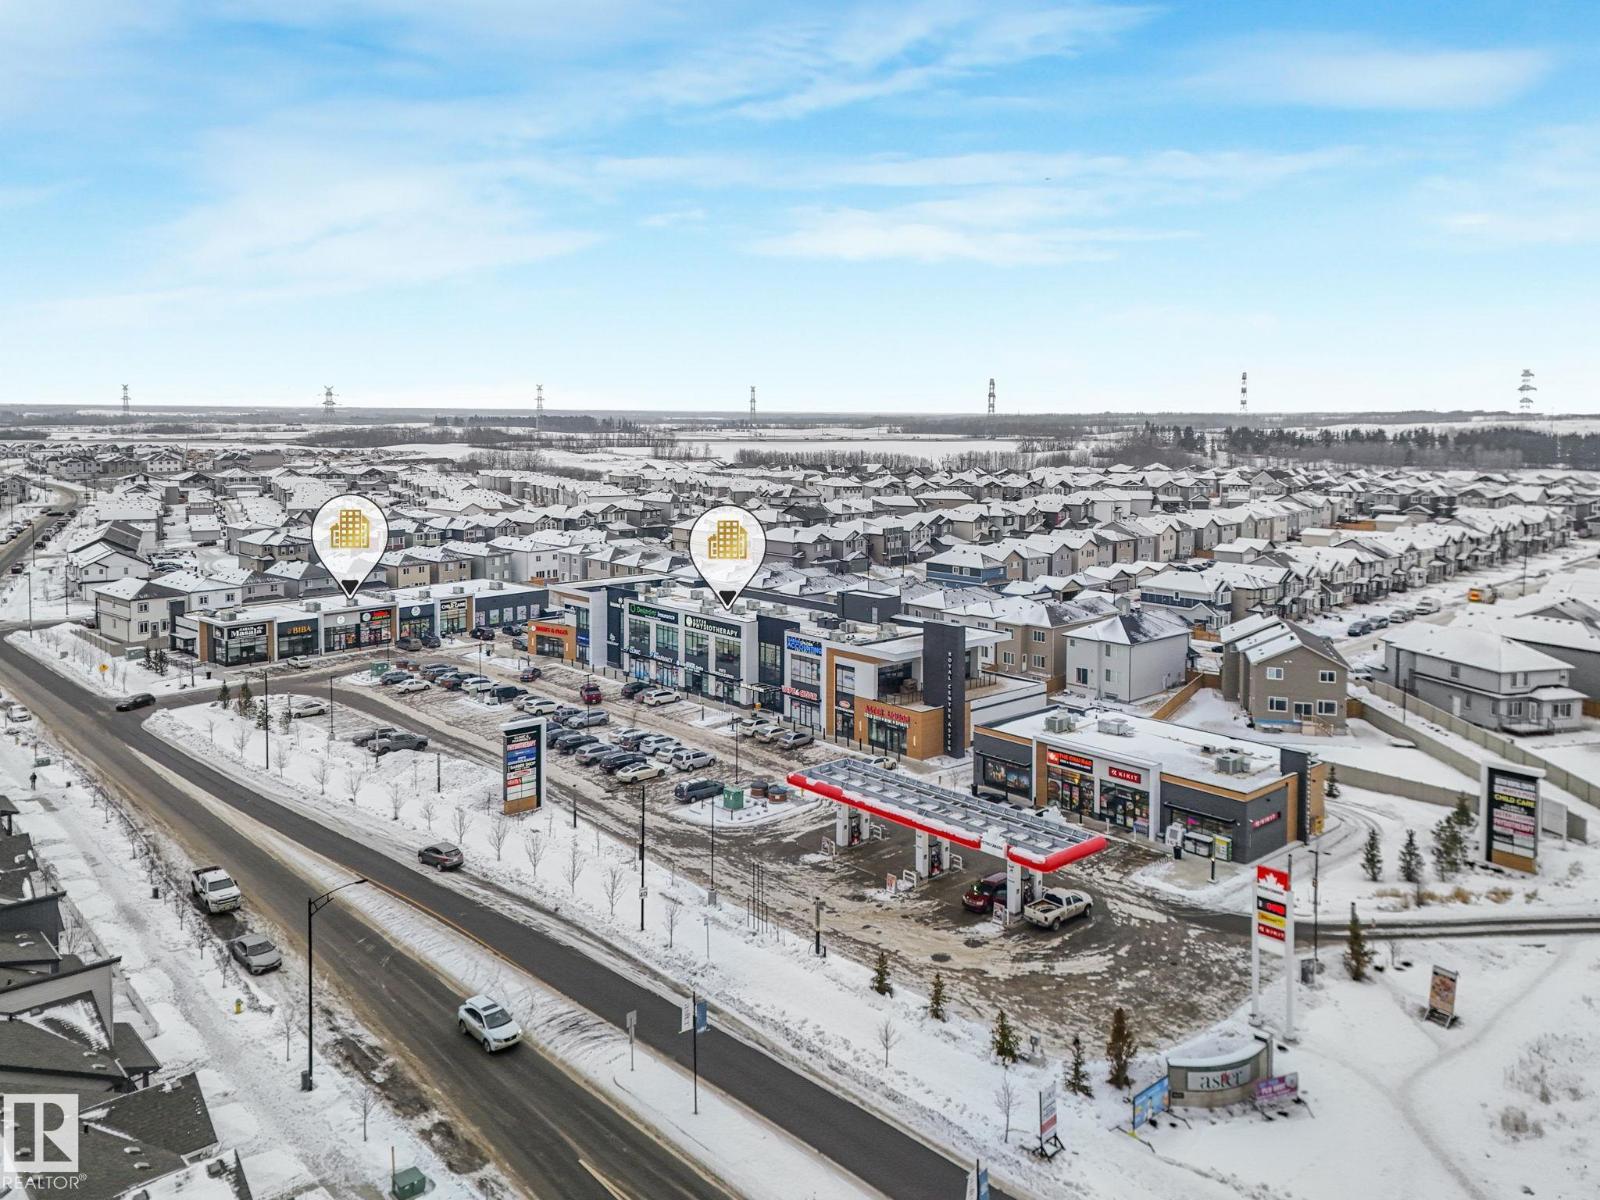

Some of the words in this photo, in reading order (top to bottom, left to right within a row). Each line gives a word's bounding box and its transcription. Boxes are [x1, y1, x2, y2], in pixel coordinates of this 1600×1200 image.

[293, 624, 311, 634] BIBA
[693, 621, 738, 637] PHYSIOTHERAPY
[1494, 793, 1515, 803] CHILD
[1516, 797, 1536, 808] CARE
